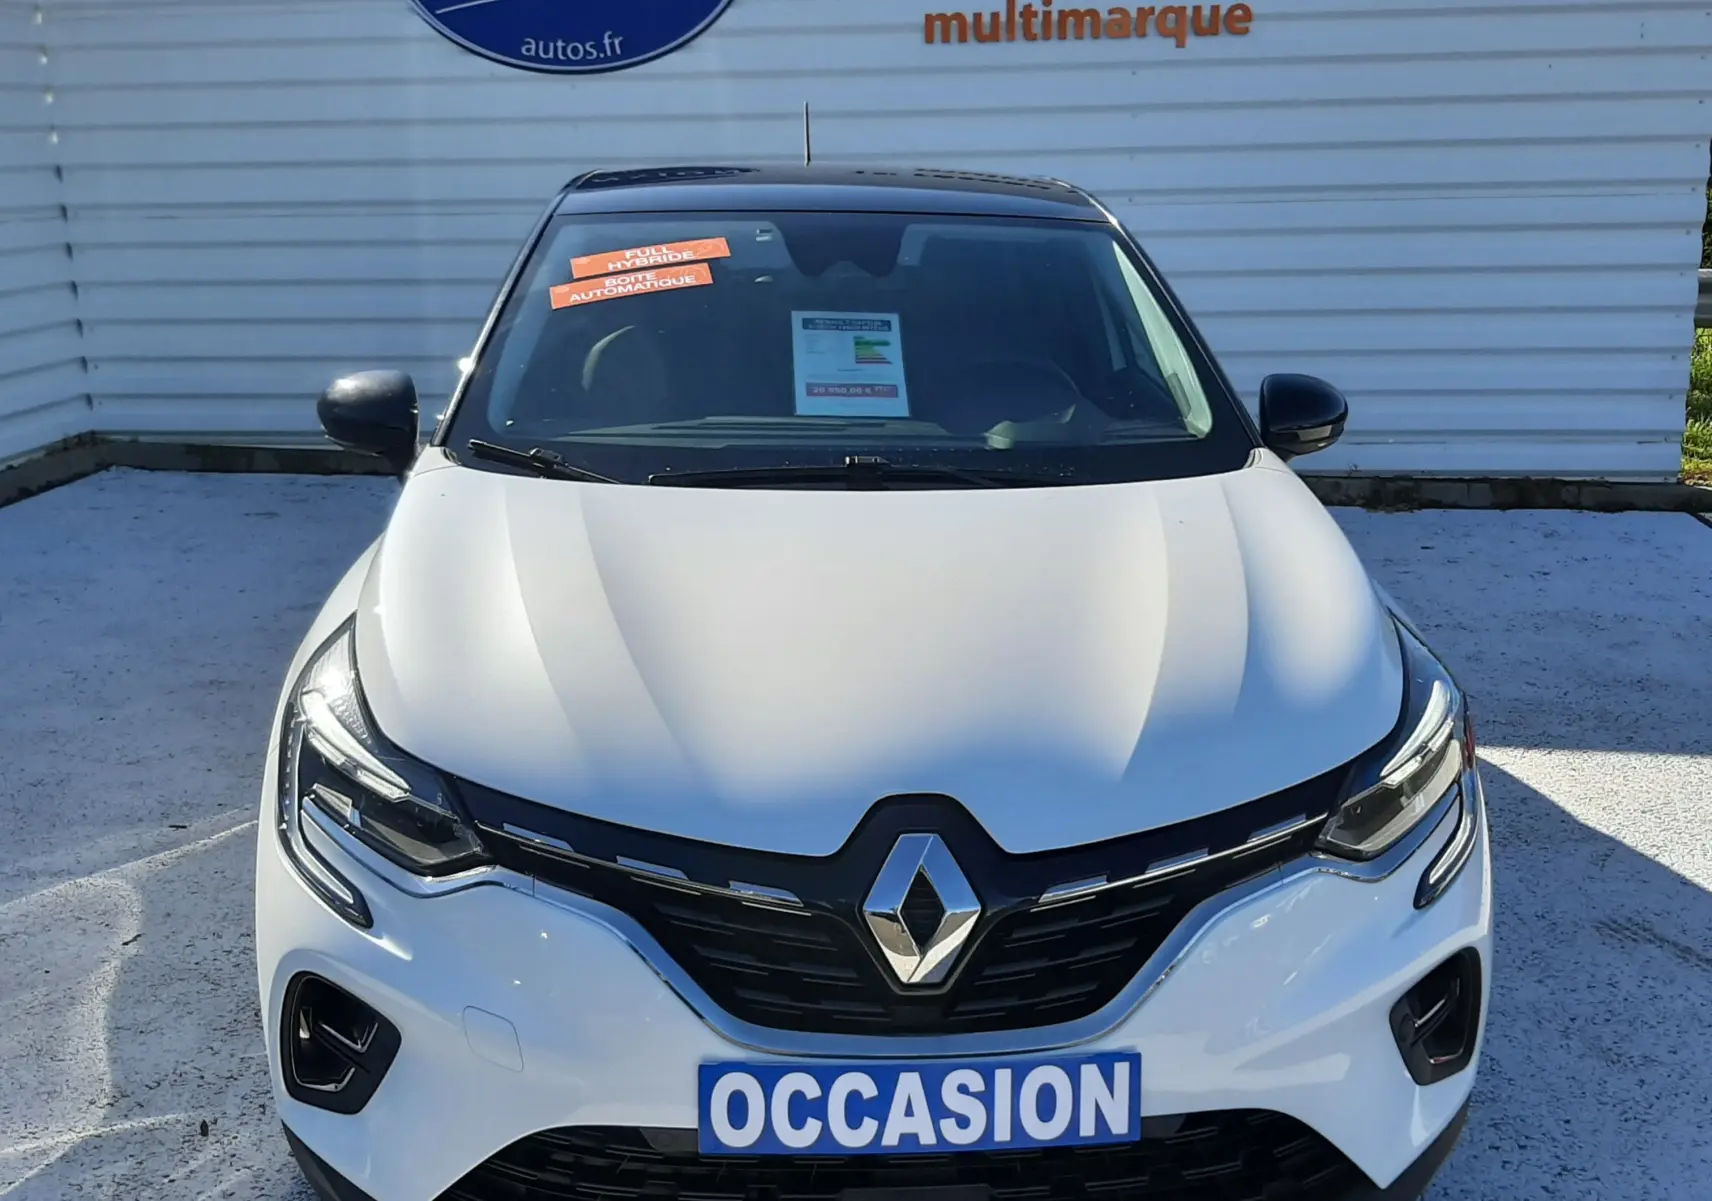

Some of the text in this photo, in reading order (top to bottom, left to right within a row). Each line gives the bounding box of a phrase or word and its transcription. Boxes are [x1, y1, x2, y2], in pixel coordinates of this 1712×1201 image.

[924, 0, 1253, 48] multimarque
[520, 31, 623, 60] autos.fr
[607, 250, 696, 271] HYBRIDE
[624, 245, 674, 260] FULL
[569, 275, 697, 303] AUTOMATIQUE
[604, 271, 657, 288] BOITE
[710, 1061, 1131, 1149] OCCASION
